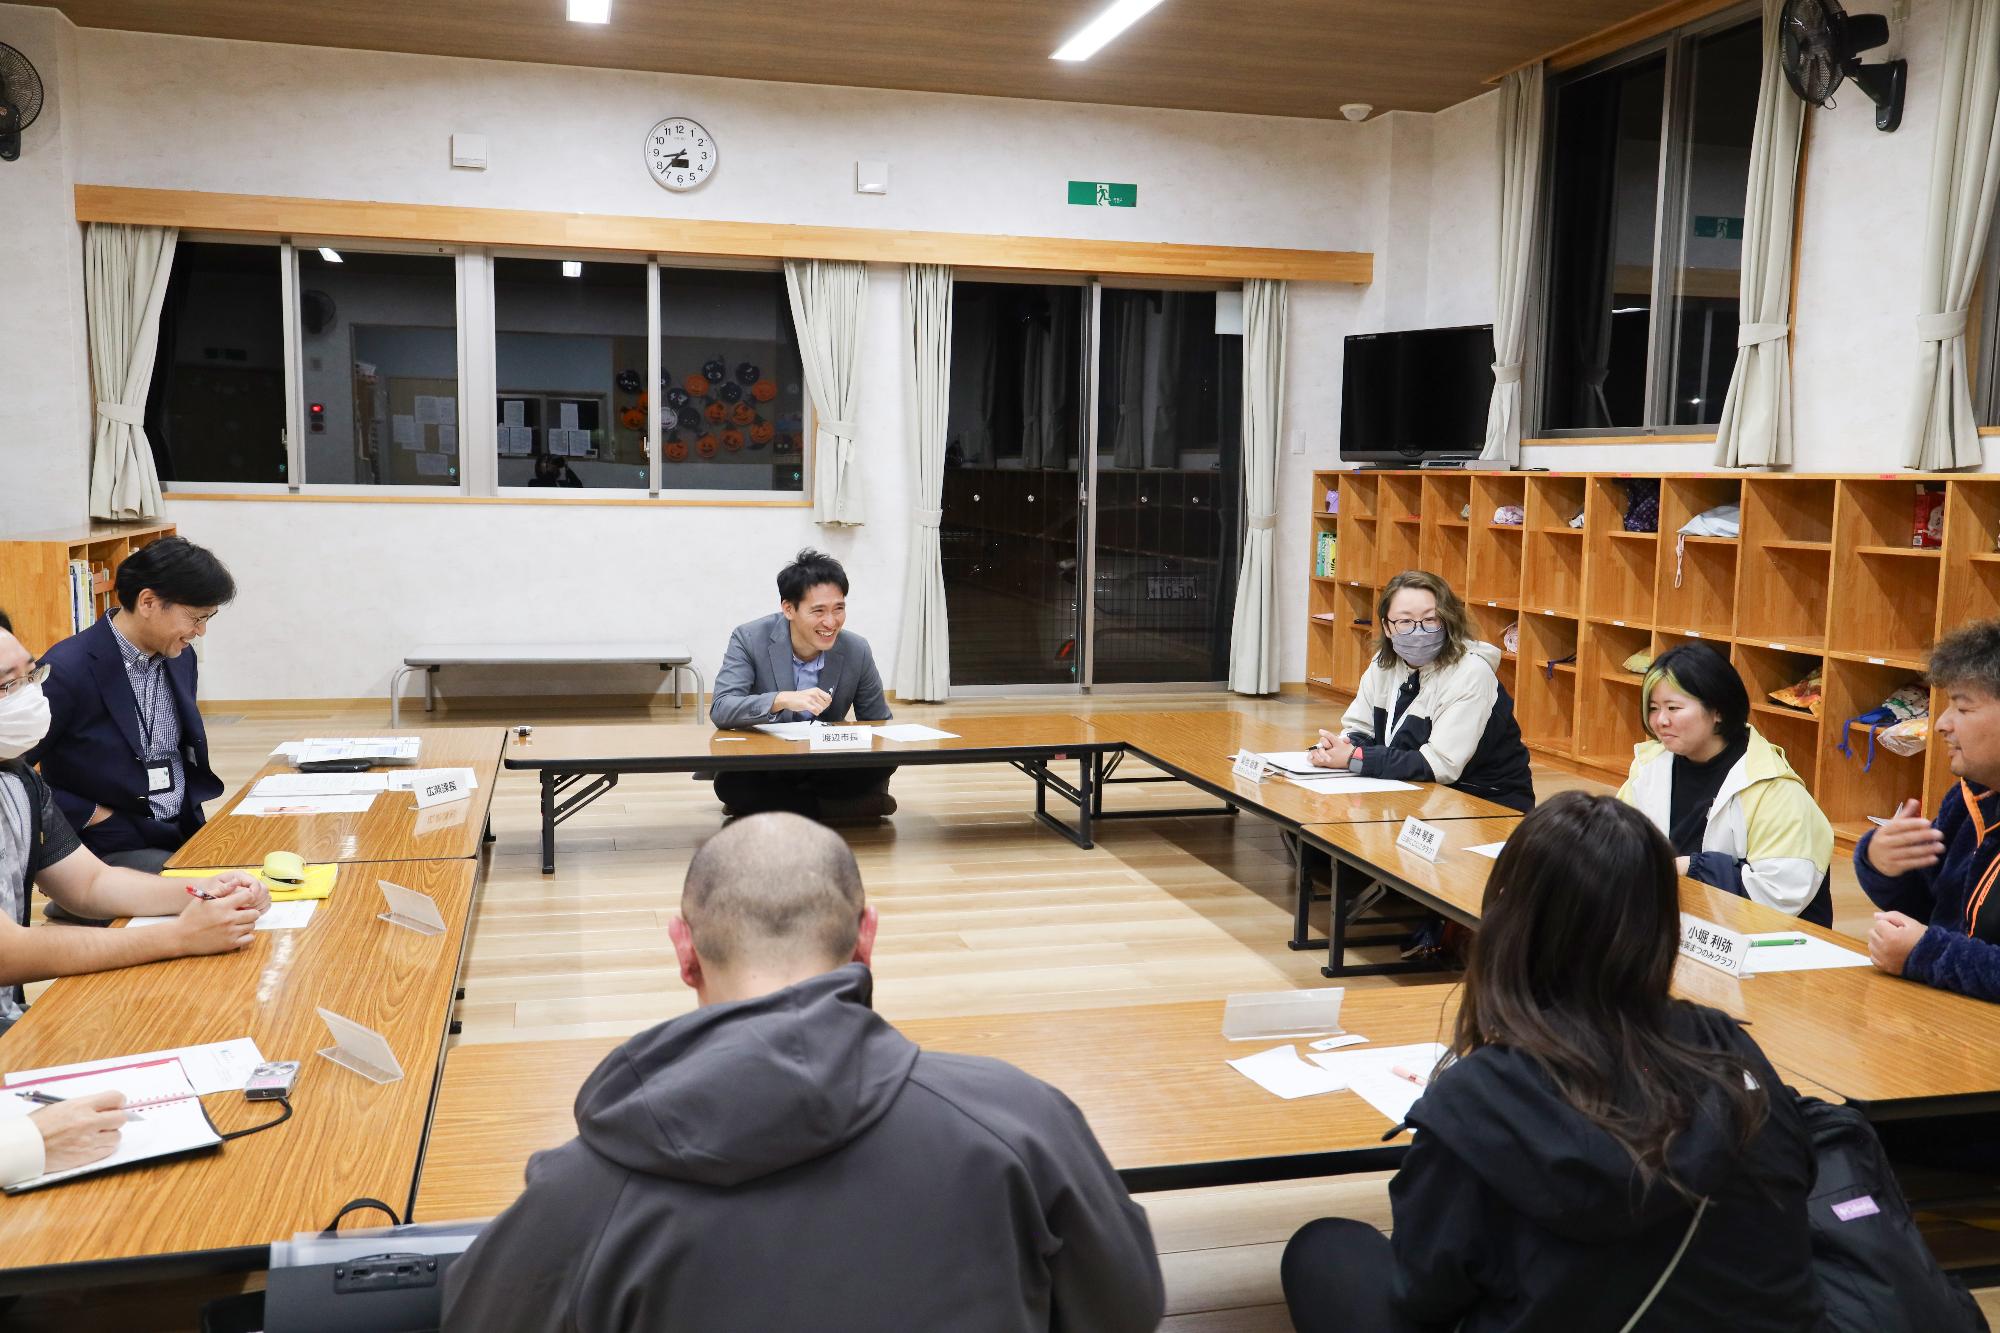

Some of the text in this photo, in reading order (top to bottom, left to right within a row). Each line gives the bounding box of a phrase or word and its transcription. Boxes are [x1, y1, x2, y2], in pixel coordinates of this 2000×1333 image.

[664, 127, 671, 136] 11
[675, 125, 685, 134] 12
[690, 129, 694, 138] 1
[655, 136, 665, 145] 10
[697, 138, 704, 147] 2
[653, 148, 660, 157] 9
[701, 151, 708, 160] 3
[656, 161, 663, 170] 8
[697, 164, 704, 172] 4
[665, 170, 672, 179] 7
[676, 174, 684, 183] 6
[689, 172, 696, 181] 5
[1687, 926, 1734, 954] 小堀 利弥
